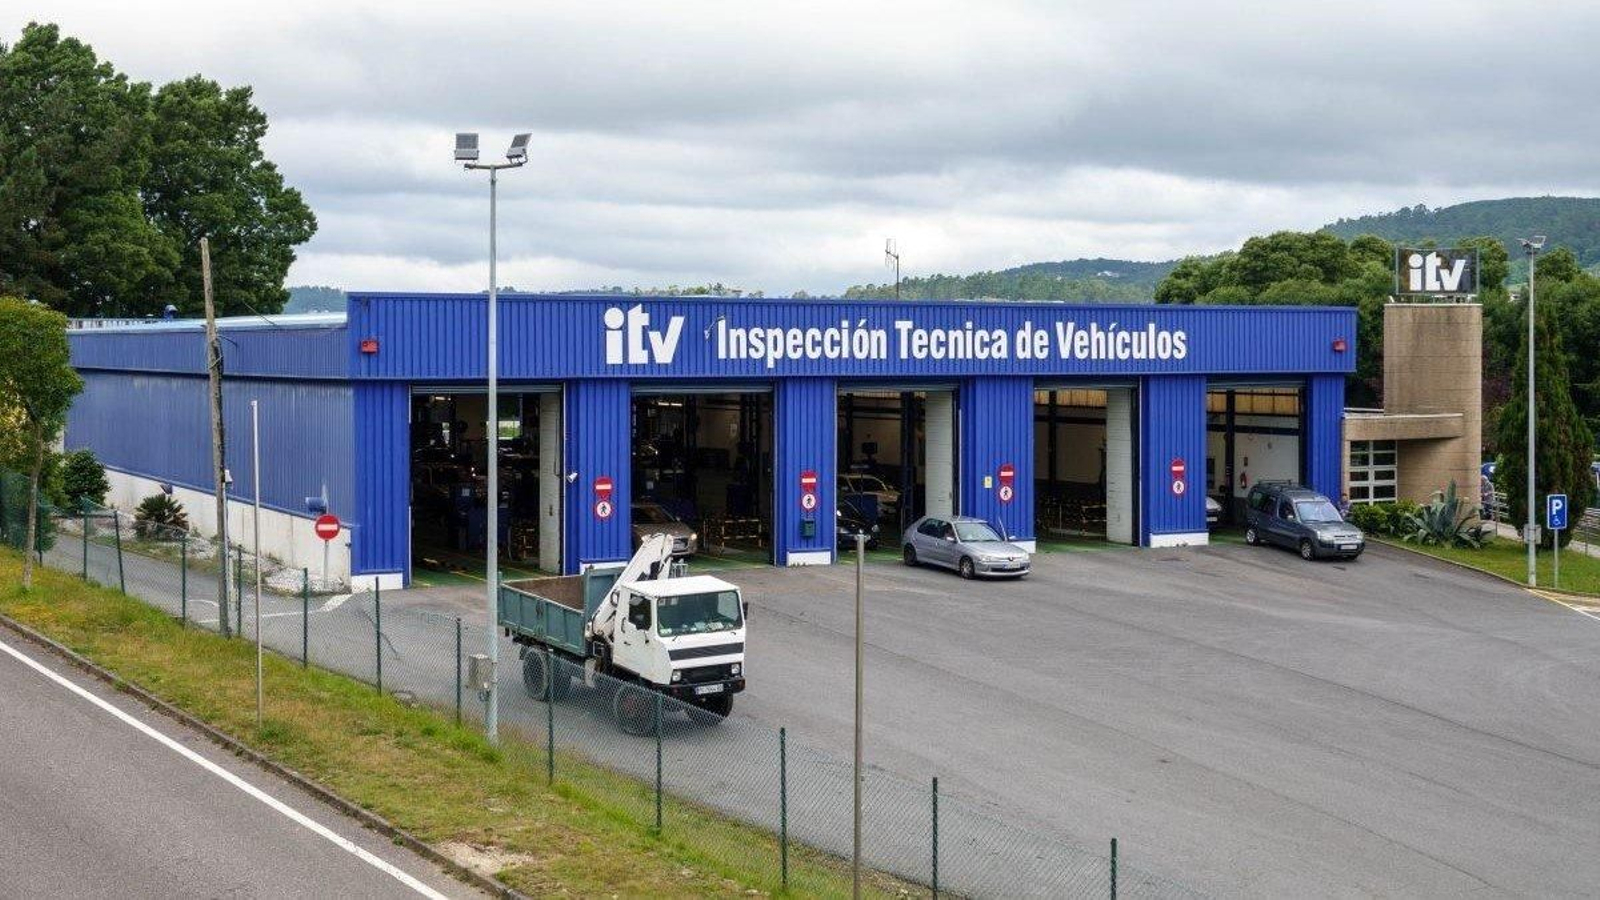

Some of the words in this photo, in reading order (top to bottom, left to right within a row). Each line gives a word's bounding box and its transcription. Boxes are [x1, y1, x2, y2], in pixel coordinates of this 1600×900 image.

[1408, 251, 1466, 291] itv
[604, 303, 685, 365] itv
[717, 318, 887, 369] Inspección
[895, 320, 1008, 360] Tecnica
[1016, 321, 1049, 360] de
[1055, 321, 1187, 360] Vehículos
[1552, 499, 1563, 515] P
